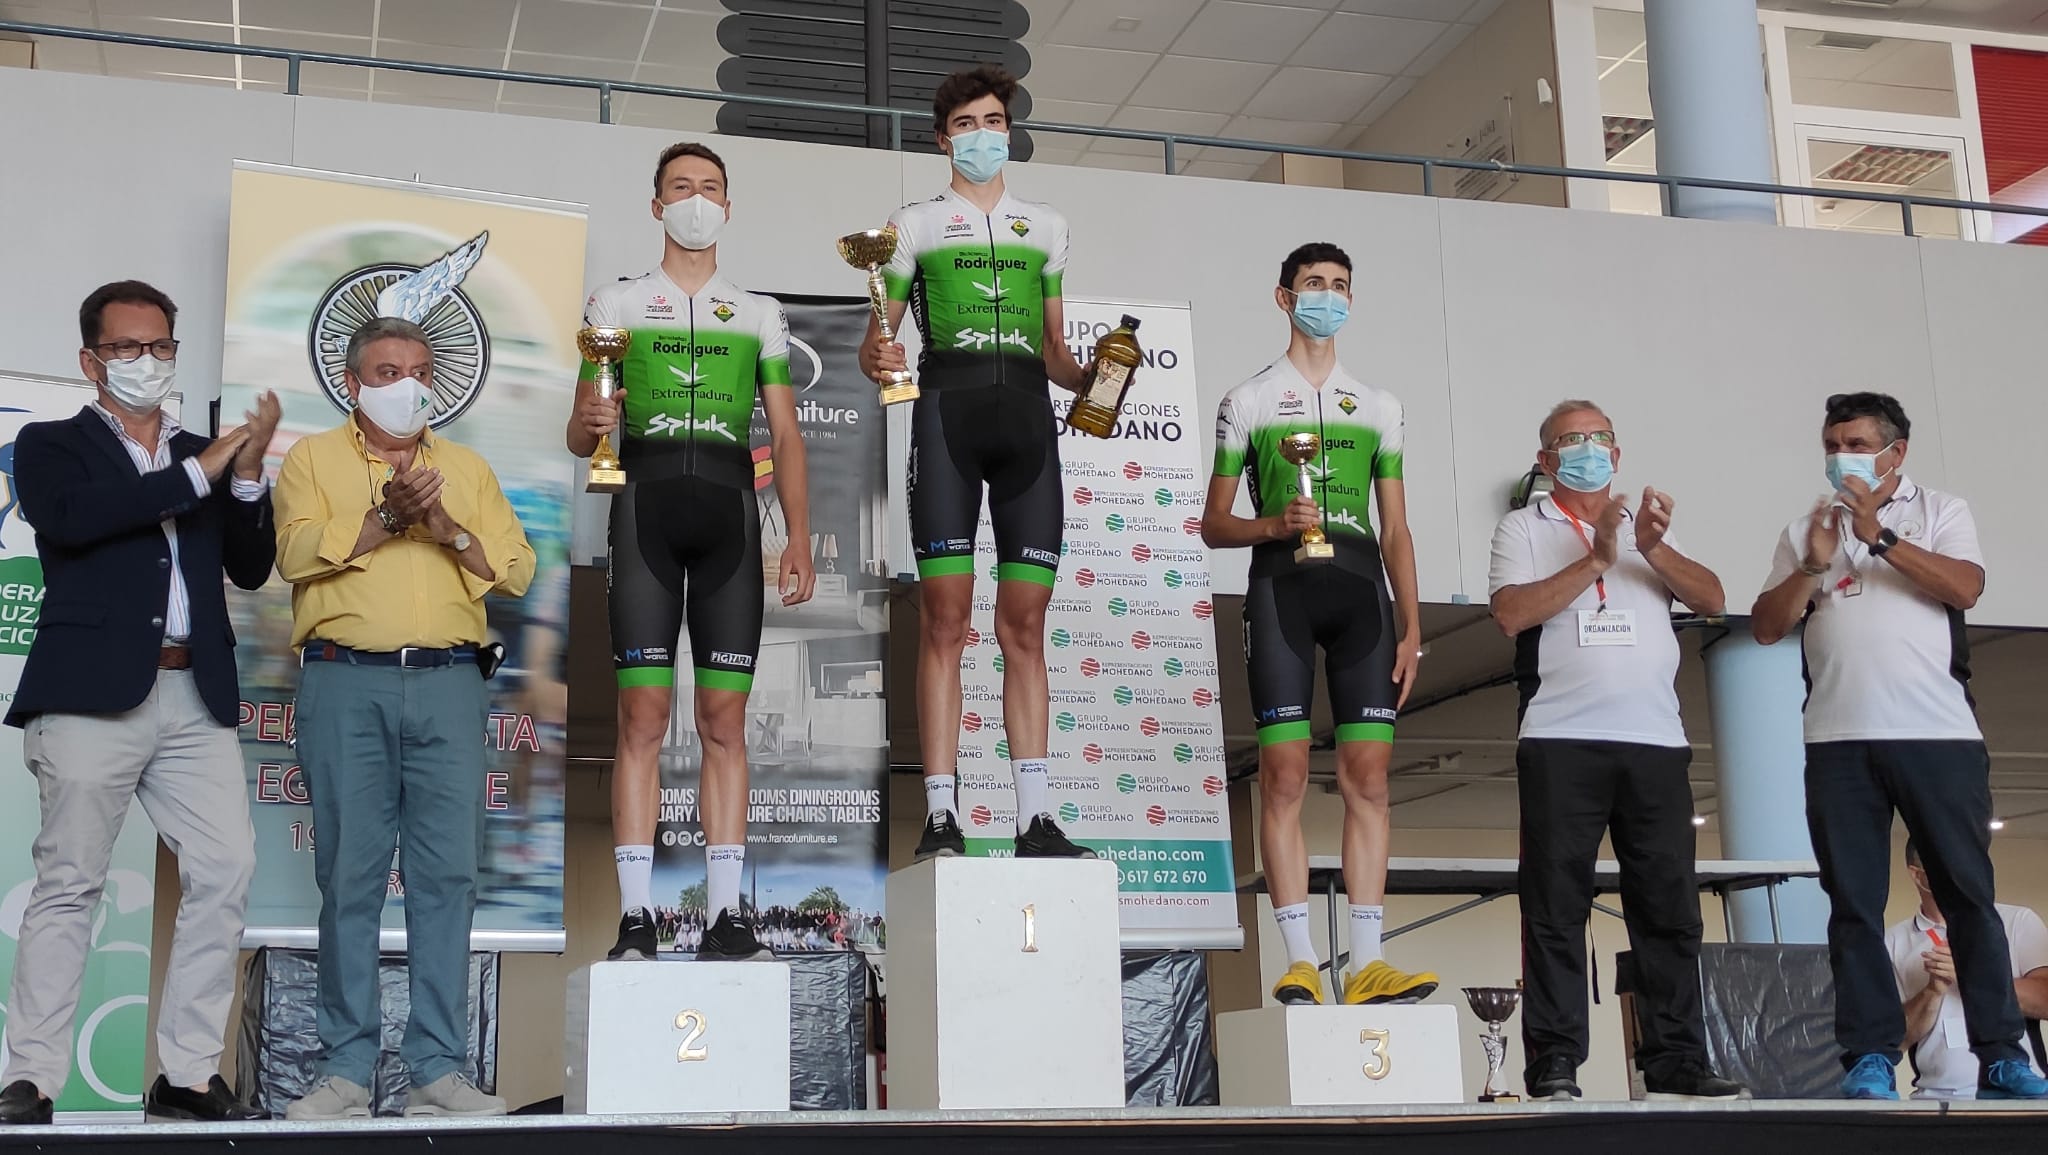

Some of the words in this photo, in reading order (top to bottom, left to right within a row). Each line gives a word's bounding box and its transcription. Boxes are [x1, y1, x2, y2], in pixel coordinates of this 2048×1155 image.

[954, 256, 1027, 272] Rodríguez
[957, 303, 1030, 318] Extremadura
[953, 327, 1034, 354] Spiuk
[653, 339, 729, 357] Rodríguez
[651, 388, 733, 403] Extremadura
[644, 412, 737, 442] Spiuk
[1065, 461, 1095, 469] GRUPO
[1065, 469, 1116, 478] MOHEDANO
[1144, 472, 1194, 480] MOHEDANO
[1175, 490, 1205, 498] GRUPO
[1094, 497, 1145, 505] MOHEDANO
[1126, 516, 1156, 524] GRUPO
[1126, 524, 1176, 533] MOHEDANO
[1070, 541, 1100, 549] GRUPO
[1070, 549, 1122, 557] MOHEDANO
[1153, 554, 1203, 562] MOHEDANO
[1097, 578, 1148, 587] MOHEDANO
[1129, 600, 1160, 608] GRUPO
[1129, 608, 1180, 617] MOHEDANO
[1072, 639, 1124, 648] MOHEDANO
[1152, 641, 1203, 650] MOHEDANO
[1102, 668, 1153, 677] MOHEDANO
[1135, 689, 1165, 697] GRUPO
[1135, 696, 1186, 705] MOHEDANO
[1077, 714, 1108, 722] GRUPO
[1078, 722, 1130, 731] MOHEDANO
[1162, 727, 1213, 736] MOHEDANO
[1105, 753, 1157, 762] MOHEDANO
[963, 773, 994, 781] GRUPO
[1138, 776, 1169, 784] GRUPO
[1138, 784, 1191, 793] MOHEDANO
[789, 789, 880, 806] DININGROOMS
[1081, 804, 1112, 813] GRUPO
[775, 806, 827, 823] CHAIRS
[829, 807, 881, 823] TABLES
[1081, 813, 1134, 822] MOHEDANO
[1168, 815, 1220, 824] MOHEDANO
[1127, 870, 1149, 884] 617
[1154, 870, 1178, 884] 672
[1183, 870, 1207, 884] 670
[1021, 903, 1039, 953] 1
[674, 1008, 709, 1063] 2
[1359, 1028, 1392, 1081] 3
